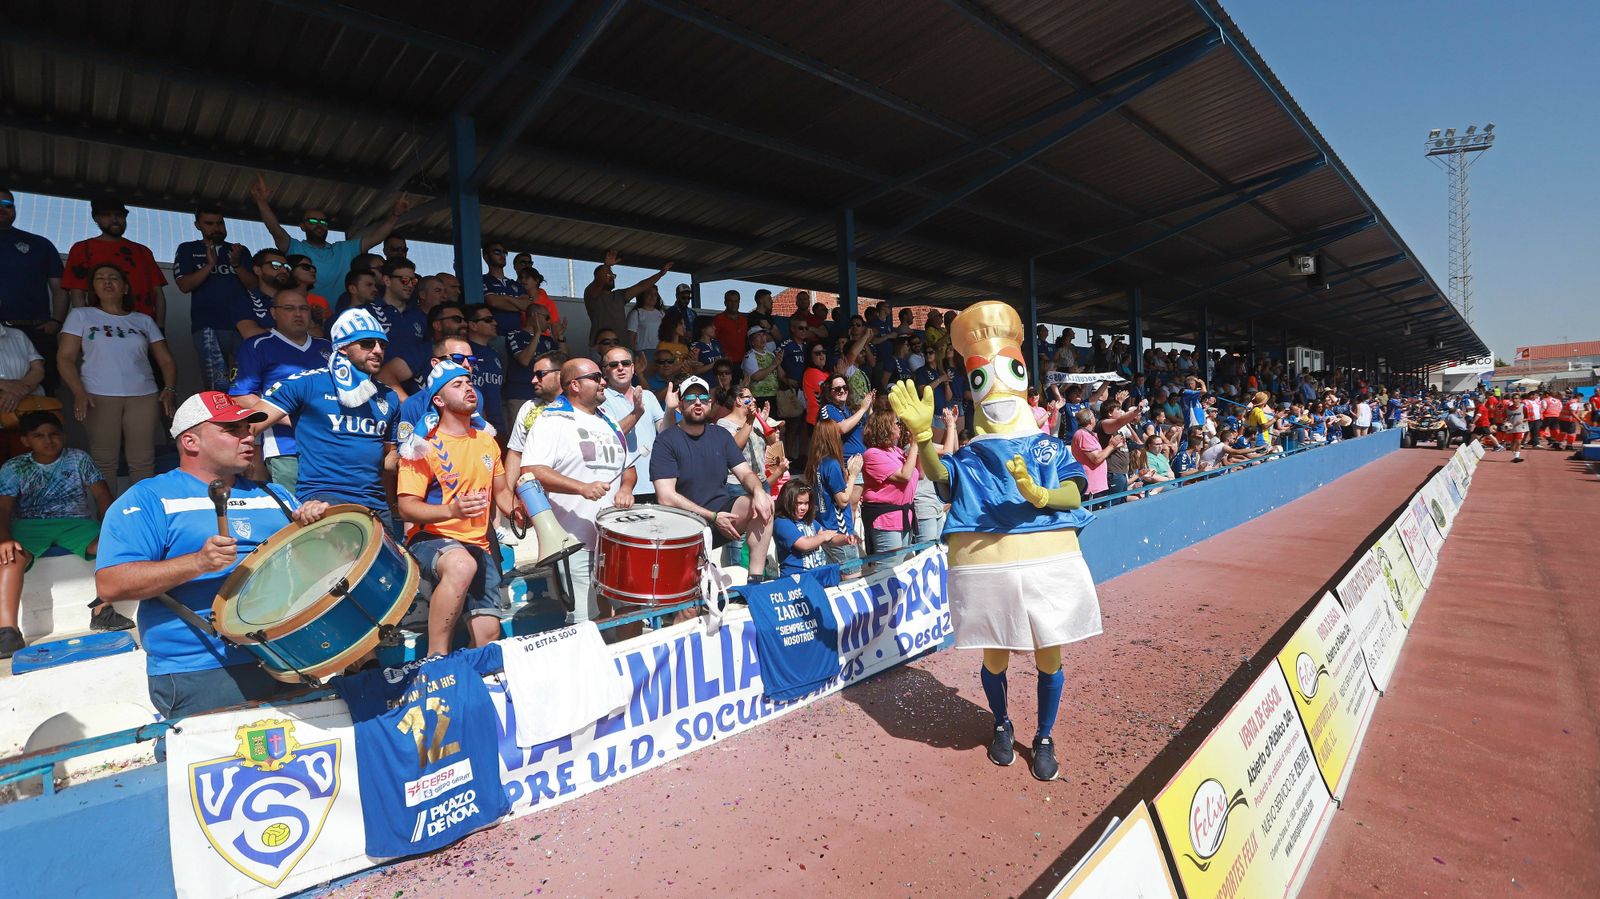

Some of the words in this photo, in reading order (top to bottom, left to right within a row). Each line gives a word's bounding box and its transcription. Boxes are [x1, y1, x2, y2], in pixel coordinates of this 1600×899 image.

[328, 414, 387, 436] YUGO
[774, 602, 810, 621] ZARCO
[804, 619, 818, 630] CON
[535, 635, 558, 649] ESTAS
[559, 628, 577, 640] SOLO
[397, 697, 460, 768] 12
[1239, 716, 1259, 750] VENTA
[1255, 705, 1266, 730] DE
[587, 734, 665, 782] U.D.
[1247, 752, 1266, 787] Abierto
[422, 769, 455, 789] CEPSA
[427, 820, 446, 837] DE
[446, 803, 480, 828] NOVA
[430, 789, 476, 820] PICAZO
[1261, 805, 1277, 838] NUEVO
[1242, 829, 1258, 870] FELIX
